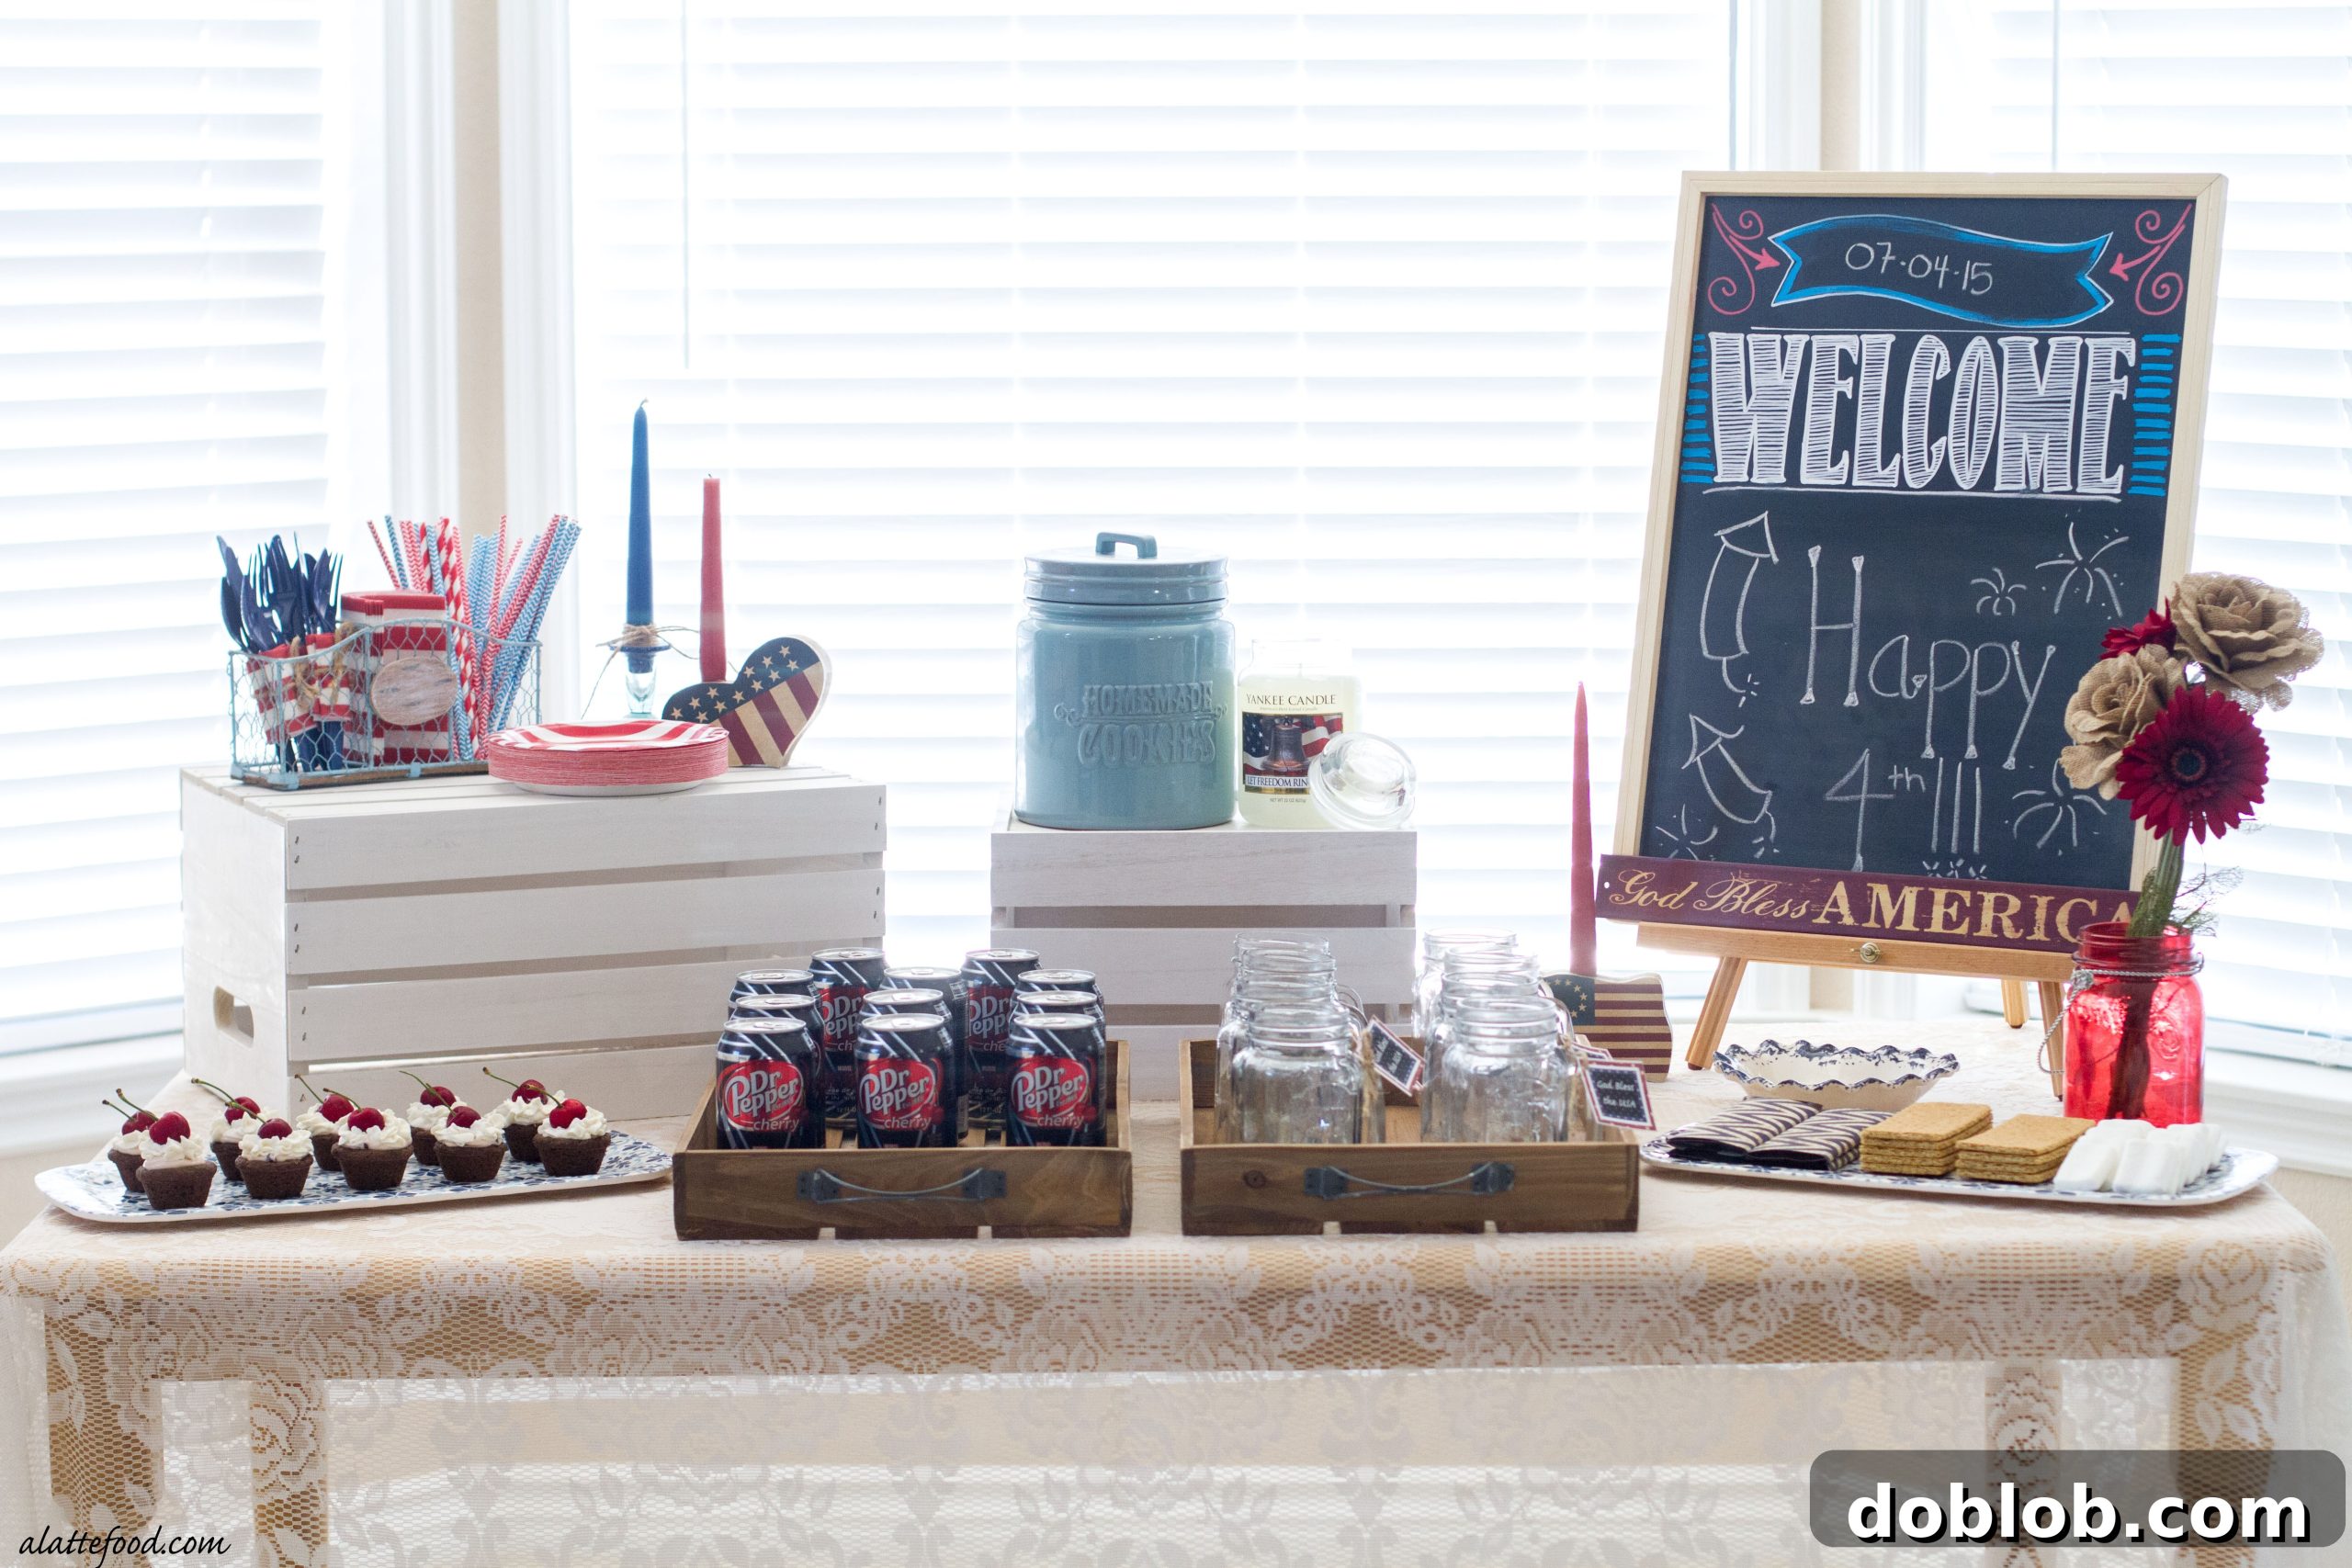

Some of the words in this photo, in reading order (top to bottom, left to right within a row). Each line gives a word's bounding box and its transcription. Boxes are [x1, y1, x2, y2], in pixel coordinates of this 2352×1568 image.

[1708, 333, 2136, 493] WELCOME
[1799, 545, 2056, 770] Happy
[1082, 680, 1214, 716] HOMEMADE
[1246, 694, 1284, 705] YANKEE
[1288, 694, 1337, 705] CANDLE
[1078, 720, 1216, 765] COOKIES
[1248, 776, 1257, 785] LET
[1257, 777, 1291, 787] FREEDOM
[1294, 777, 1308, 787] RIN
[1609, 869, 1698, 910] God
[1693, 874, 1811, 919] Bless
[834, 996, 862, 1019] Dr
[981, 996, 1010, 1019] Dr
[750, 1070, 782, 1094] Dr
[879, 1068, 910, 1093] Dr
[1034, 1066, 1066, 1091] Dr
[725, 1076, 799, 1118] Pepper
[859, 1073, 930, 1115] Pepper
[1012, 1071, 1084, 1113] Pepper
[753, 1118, 800, 1133] cherry
[884, 1117, 932, 1132] cherry
[1036, 1114, 1084, 1130] cherry
